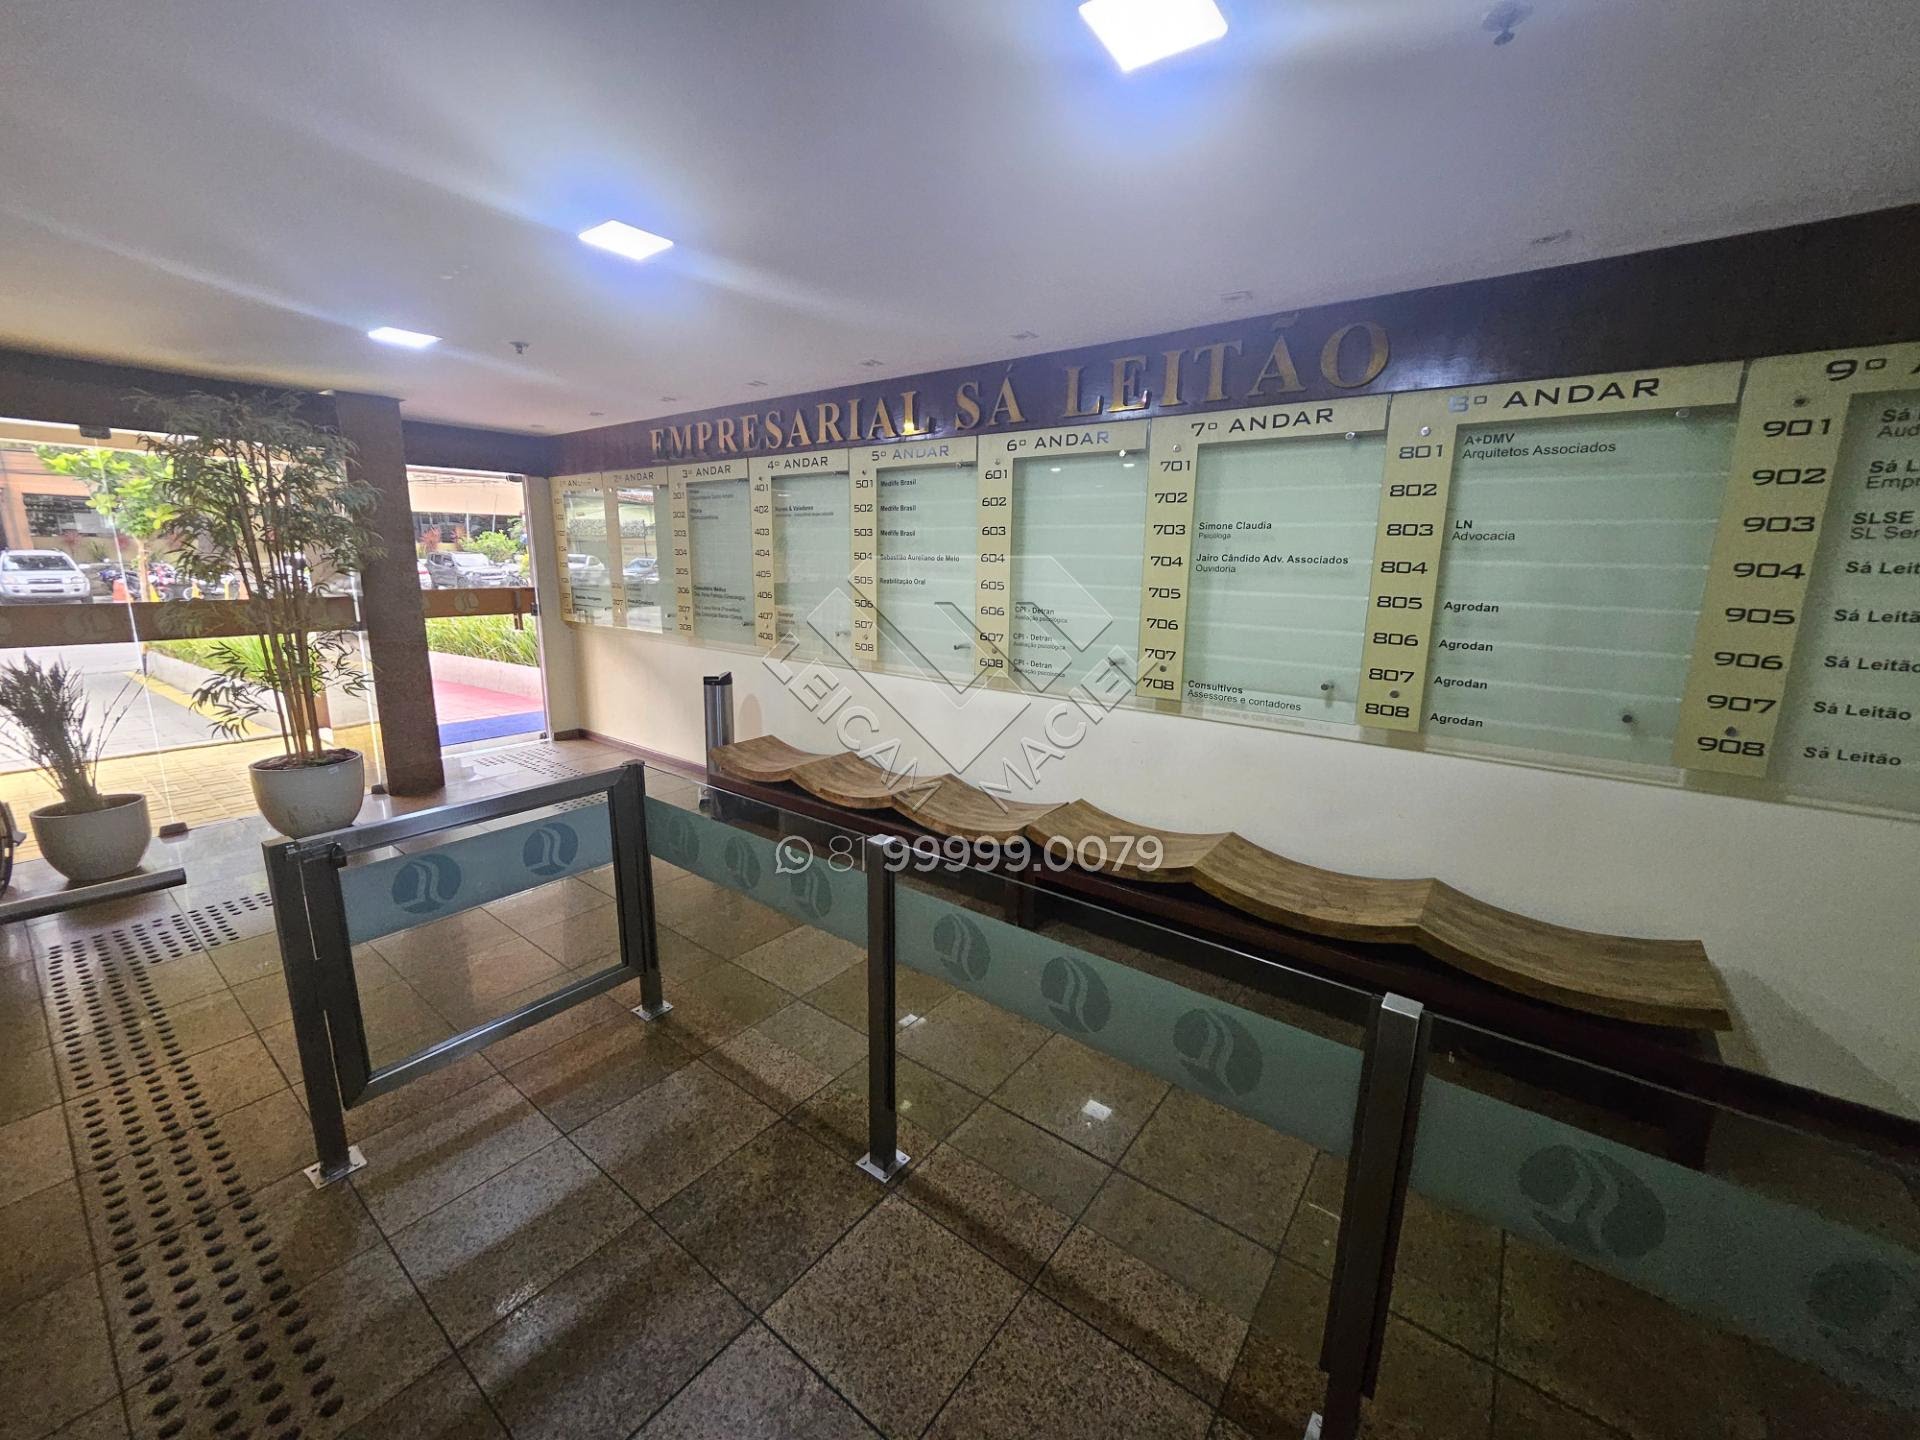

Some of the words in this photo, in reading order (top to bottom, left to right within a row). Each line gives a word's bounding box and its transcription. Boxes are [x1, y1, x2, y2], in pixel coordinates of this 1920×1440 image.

[650, 390, 929, 461] EMPRESARIAL
[954, 363, 1026, 431] SÁ
[1061, 312, 1391, 418] LEITÃO
[1503, 377, 1660, 409] ANDAR
[1228, 407, 1334, 433] ANDAR
[1881, 407, 1912, 423] Sá
[1762, 418, 1832, 438] 901
[1034, 431, 1109, 449] ANDAR
[1464, 432, 1515, 445] A+DMV
[892, 445, 949, 460] ANDAR
[1399, 444, 1444, 460] 801
[1462, 446, 1529, 460] Arquitetos
[1532, 442, 1617, 456] Associados
[783, 456, 828, 469] ANDAR
[1160, 460, 1191, 472] 701
[1868, 459, 1899, 474] Sá
[625, 471, 654, 482] ANDAR
[696, 465, 731, 477] ANDAR
[985, 469, 1009, 480] 601
[1752, 468, 1827, 486] 902
[754, 484, 769, 492] 401
[855, 479, 874, 488] 501
[1389, 484, 1437, 498] 802
[981, 496, 1007, 507] 602
[1154, 492, 1188, 504] 702
[753, 505, 769, 514] 402
[853, 503, 874, 512] 502
[1852, 510, 1915, 525] SLSE
[981, 526, 1007, 536] 603
[1153, 524, 1186, 536] 703
[1198, 522, 1233, 530] Simone
[1235, 521, 1272, 530] Claudia
[1386, 523, 1434, 537] 803
[1455, 519, 1473, 530] LN
[1742, 516, 1816, 533] 903
[754, 528, 770, 536] 403
[853, 528, 873, 537] 503
[1198, 532, 1231, 540] Psicóloga
[1451, 530, 1516, 541] Advocacia
[1850, 527, 1877, 540] SL
[754, 549, 770, 557] 404
[853, 552, 873, 561] 504
[980, 553, 1006, 563] 604
[1196, 553, 1219, 563] Jairo
[1221, 554, 1261, 563] Cândido
[1263, 555, 1285, 564] Adv.
[1287, 555, 1349, 565] Associados
[1150, 556, 1184, 567] 704
[1380, 561, 1428, 575] 804
[1845, 561, 1872, 574] Sá
[1195, 564, 1236, 573] Ouvidoria
[1733, 562, 1806, 580] 904
[854, 575, 874, 585] 505
[980, 580, 1005, 591] 605
[757, 591, 773, 600] 406
[1148, 587, 1181, 599] 705
[854, 599, 874, 608] 506
[1376, 595, 1423, 610] 805
[1443, 601, 1500, 614] Agrodan
[758, 612, 773, 621] 407
[980, 606, 1005, 616] 606
[1032, 607, 1054, 615] Detran
[1725, 607, 1796, 625] 905
[1833, 608, 1861, 622] Sá
[854, 620, 873, 629] 507
[1146, 618, 1179, 631] 706
[758, 632, 774, 640] 408
[979, 632, 1004, 642] 607
[1030, 634, 1053, 642] Detran
[1372, 632, 1419, 647] 806
[854, 643, 874, 652] 508
[1438, 638, 1493, 652] Agrodan
[1144, 648, 1177, 661] 707
[1714, 651, 1784, 671] 906
[979, 658, 1004, 669] 608
[1030, 660, 1053, 668] Detran
[1823, 655, 1850, 669] Sá
[1368, 668, 1415, 684] 807
[1433, 675, 1488, 690] Agrodan
[1142, 677, 1175, 690] 708
[1188, 679, 1244, 694] Consultivos
[1187, 689, 1238, 704] Assessores
[1248, 698, 1302, 712] contadores
[1706, 694, 1777, 713] 907
[1364, 703, 1410, 718] 808
[1812, 701, 1839, 715] Sá
[1844, 704, 1913, 721] Leitão
[1429, 712, 1484, 728] Agrodan
[1697, 736, 1766, 757] 908
[1802, 746, 1830, 760] Sá
[1836, 749, 1903, 767] Leitão
